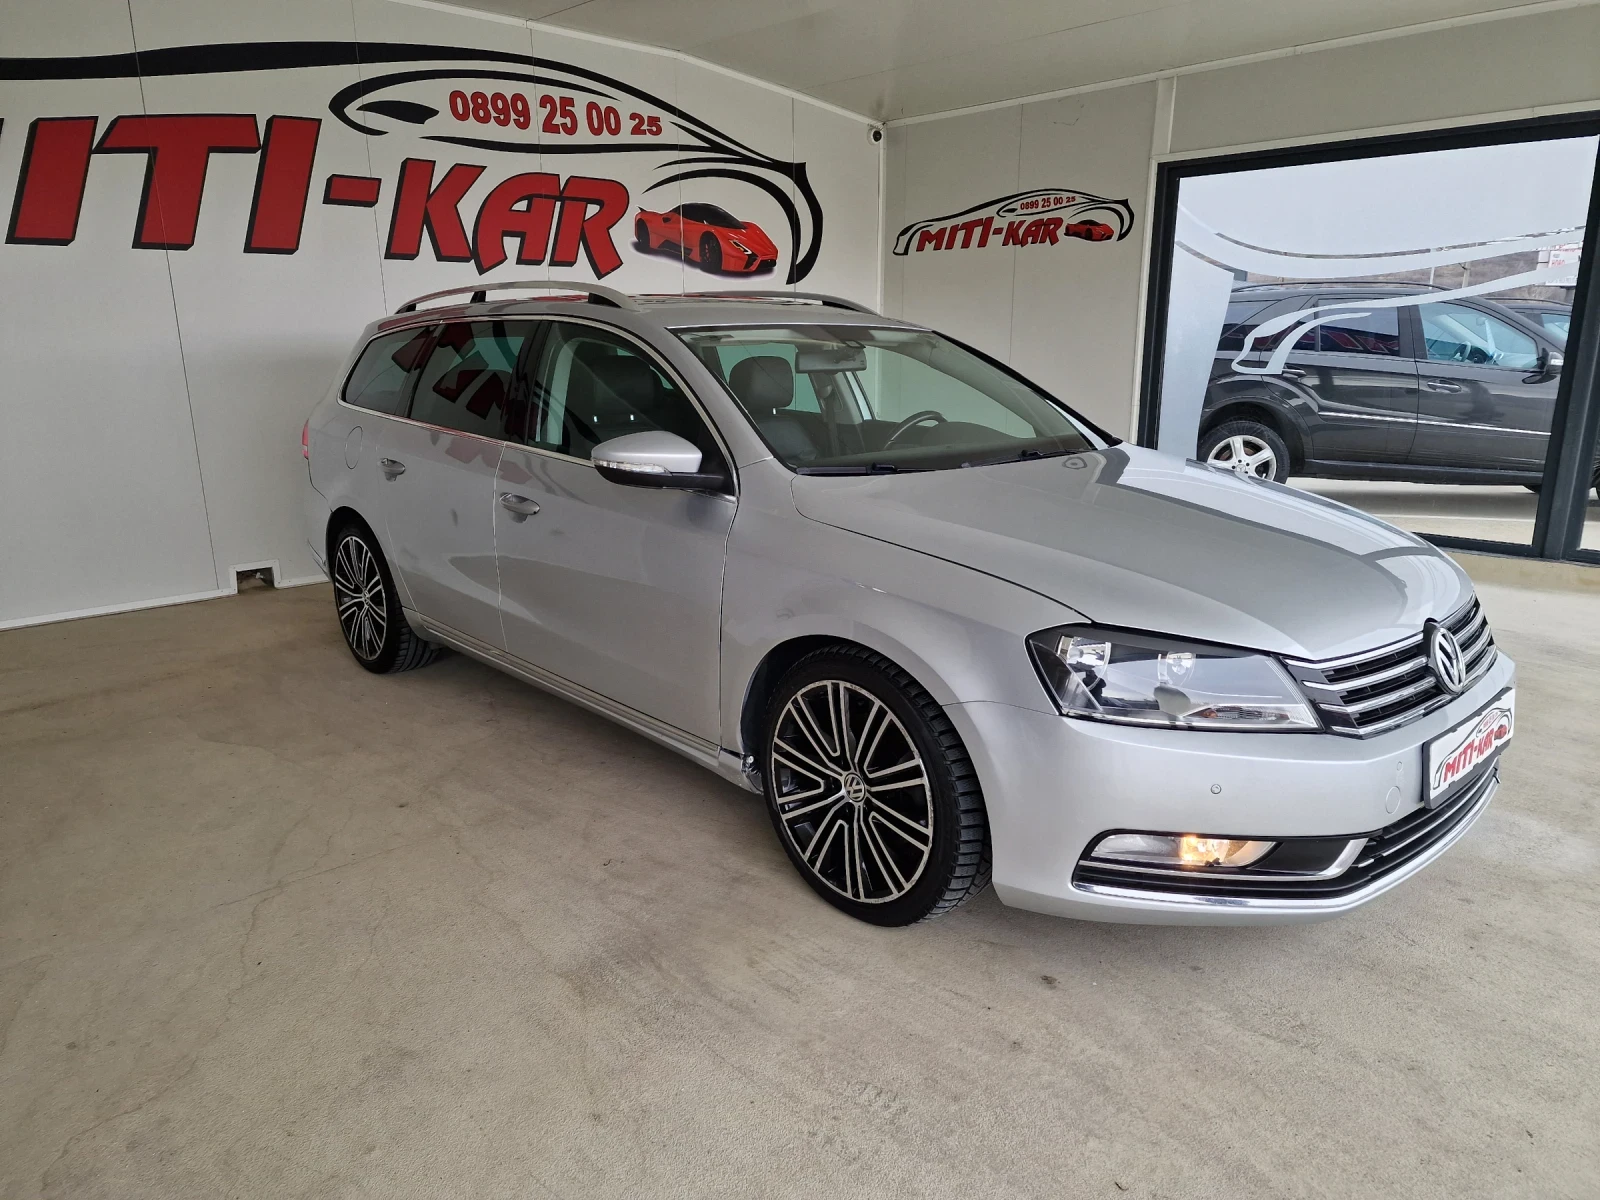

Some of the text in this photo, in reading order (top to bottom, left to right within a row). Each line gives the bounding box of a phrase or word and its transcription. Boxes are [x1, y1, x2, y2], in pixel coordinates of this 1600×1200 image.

[449, 90, 662, 136] 0899 25 00 25
[0, 114, 629, 279] ITI-KAR
[1020, 195, 1076, 210] 0899 25 00 25
[916, 217, 1063, 251] MITI-KAR
[1443, 729, 1494, 782] MITI-KAR
